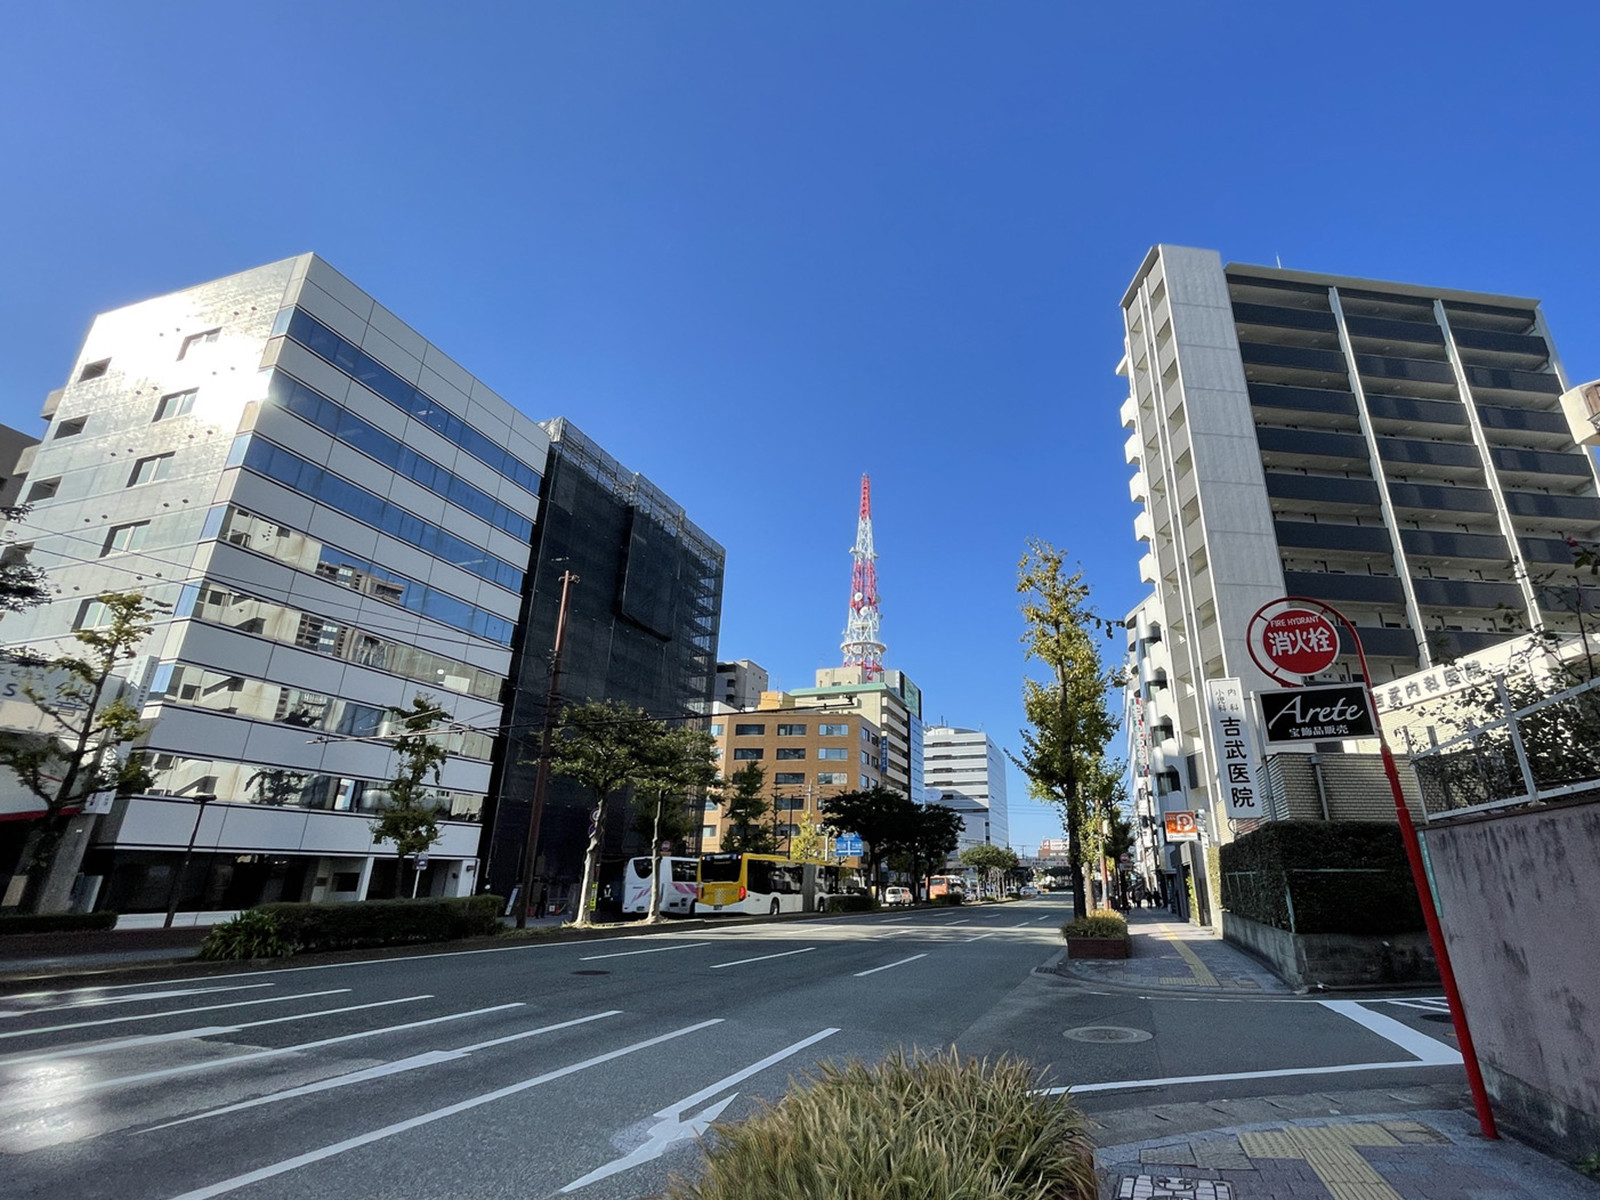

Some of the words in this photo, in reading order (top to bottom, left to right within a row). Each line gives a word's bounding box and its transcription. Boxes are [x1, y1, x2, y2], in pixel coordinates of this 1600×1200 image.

[1271, 619, 1286, 627] FIRE
[1287, 616, 1319, 626] HYDRANT
[1267, 627, 1333, 656] 消火栓
[1268, 695, 1364, 730] Arete
[1289, 724, 1349, 738] 宝飾品販売
[1220, 716, 1255, 808] 吉武医院
